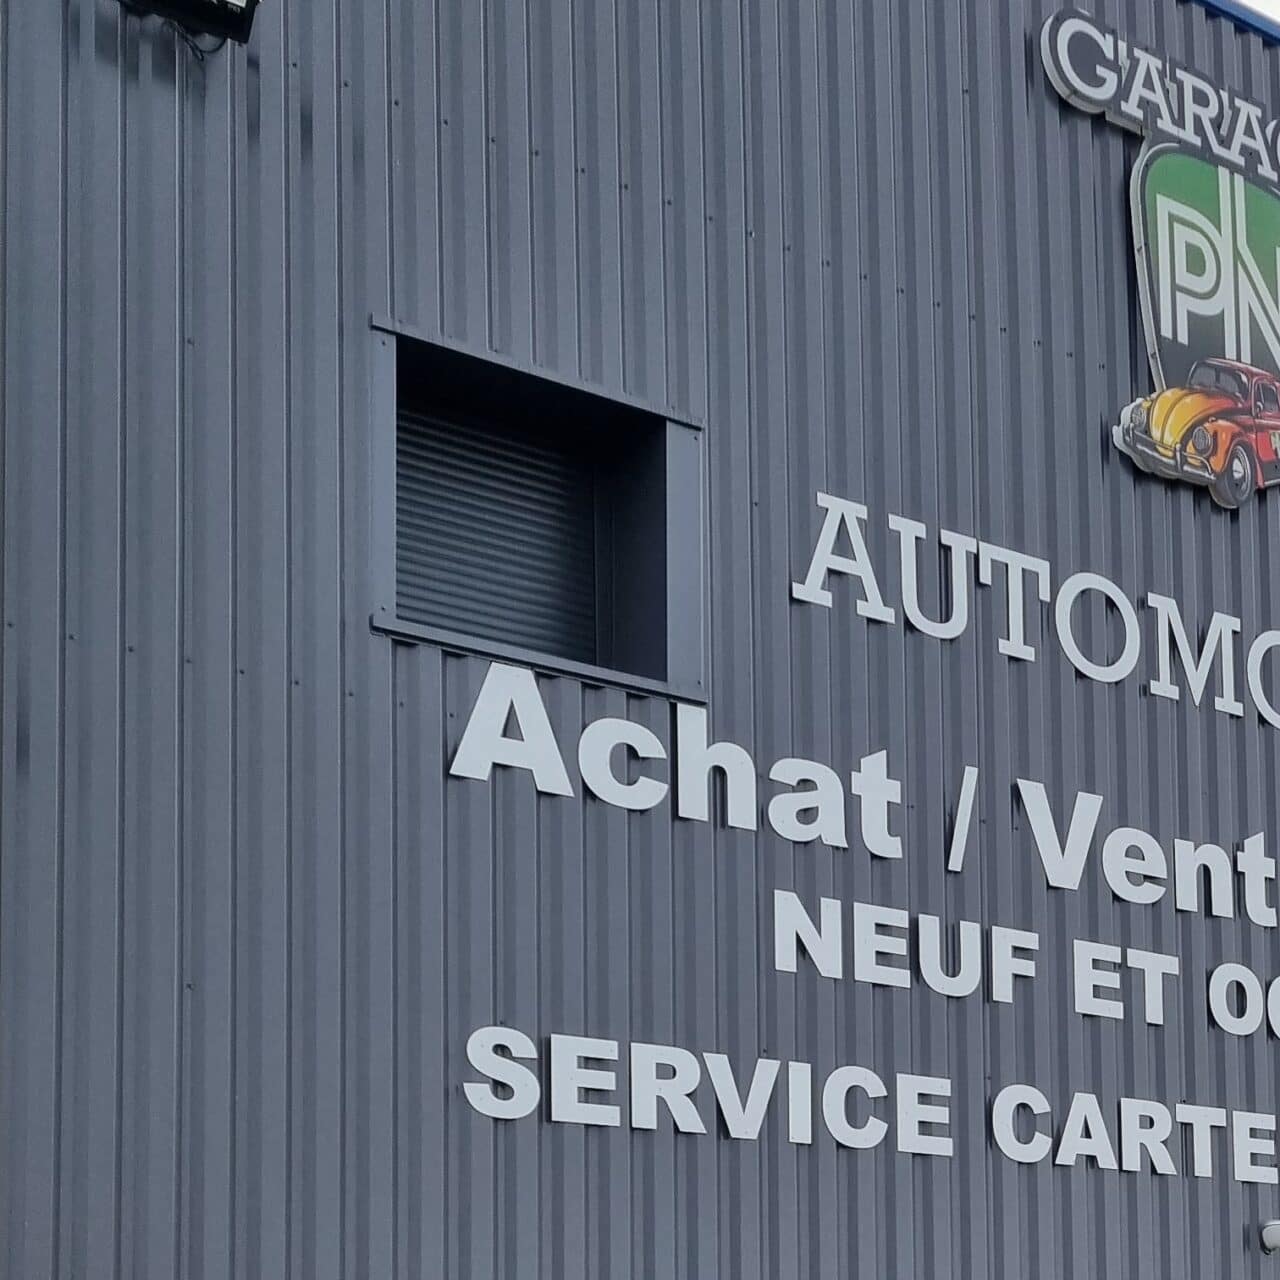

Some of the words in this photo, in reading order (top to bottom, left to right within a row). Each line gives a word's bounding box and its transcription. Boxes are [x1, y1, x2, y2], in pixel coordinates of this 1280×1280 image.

[449, 661, 903, 859] Achat
[948, 765, 979, 873] /
[774, 889, 1040, 1004] NEUF
[1073, 939, 1180, 1025] ET
[463, 1026, 954, 1157] SERVICE
